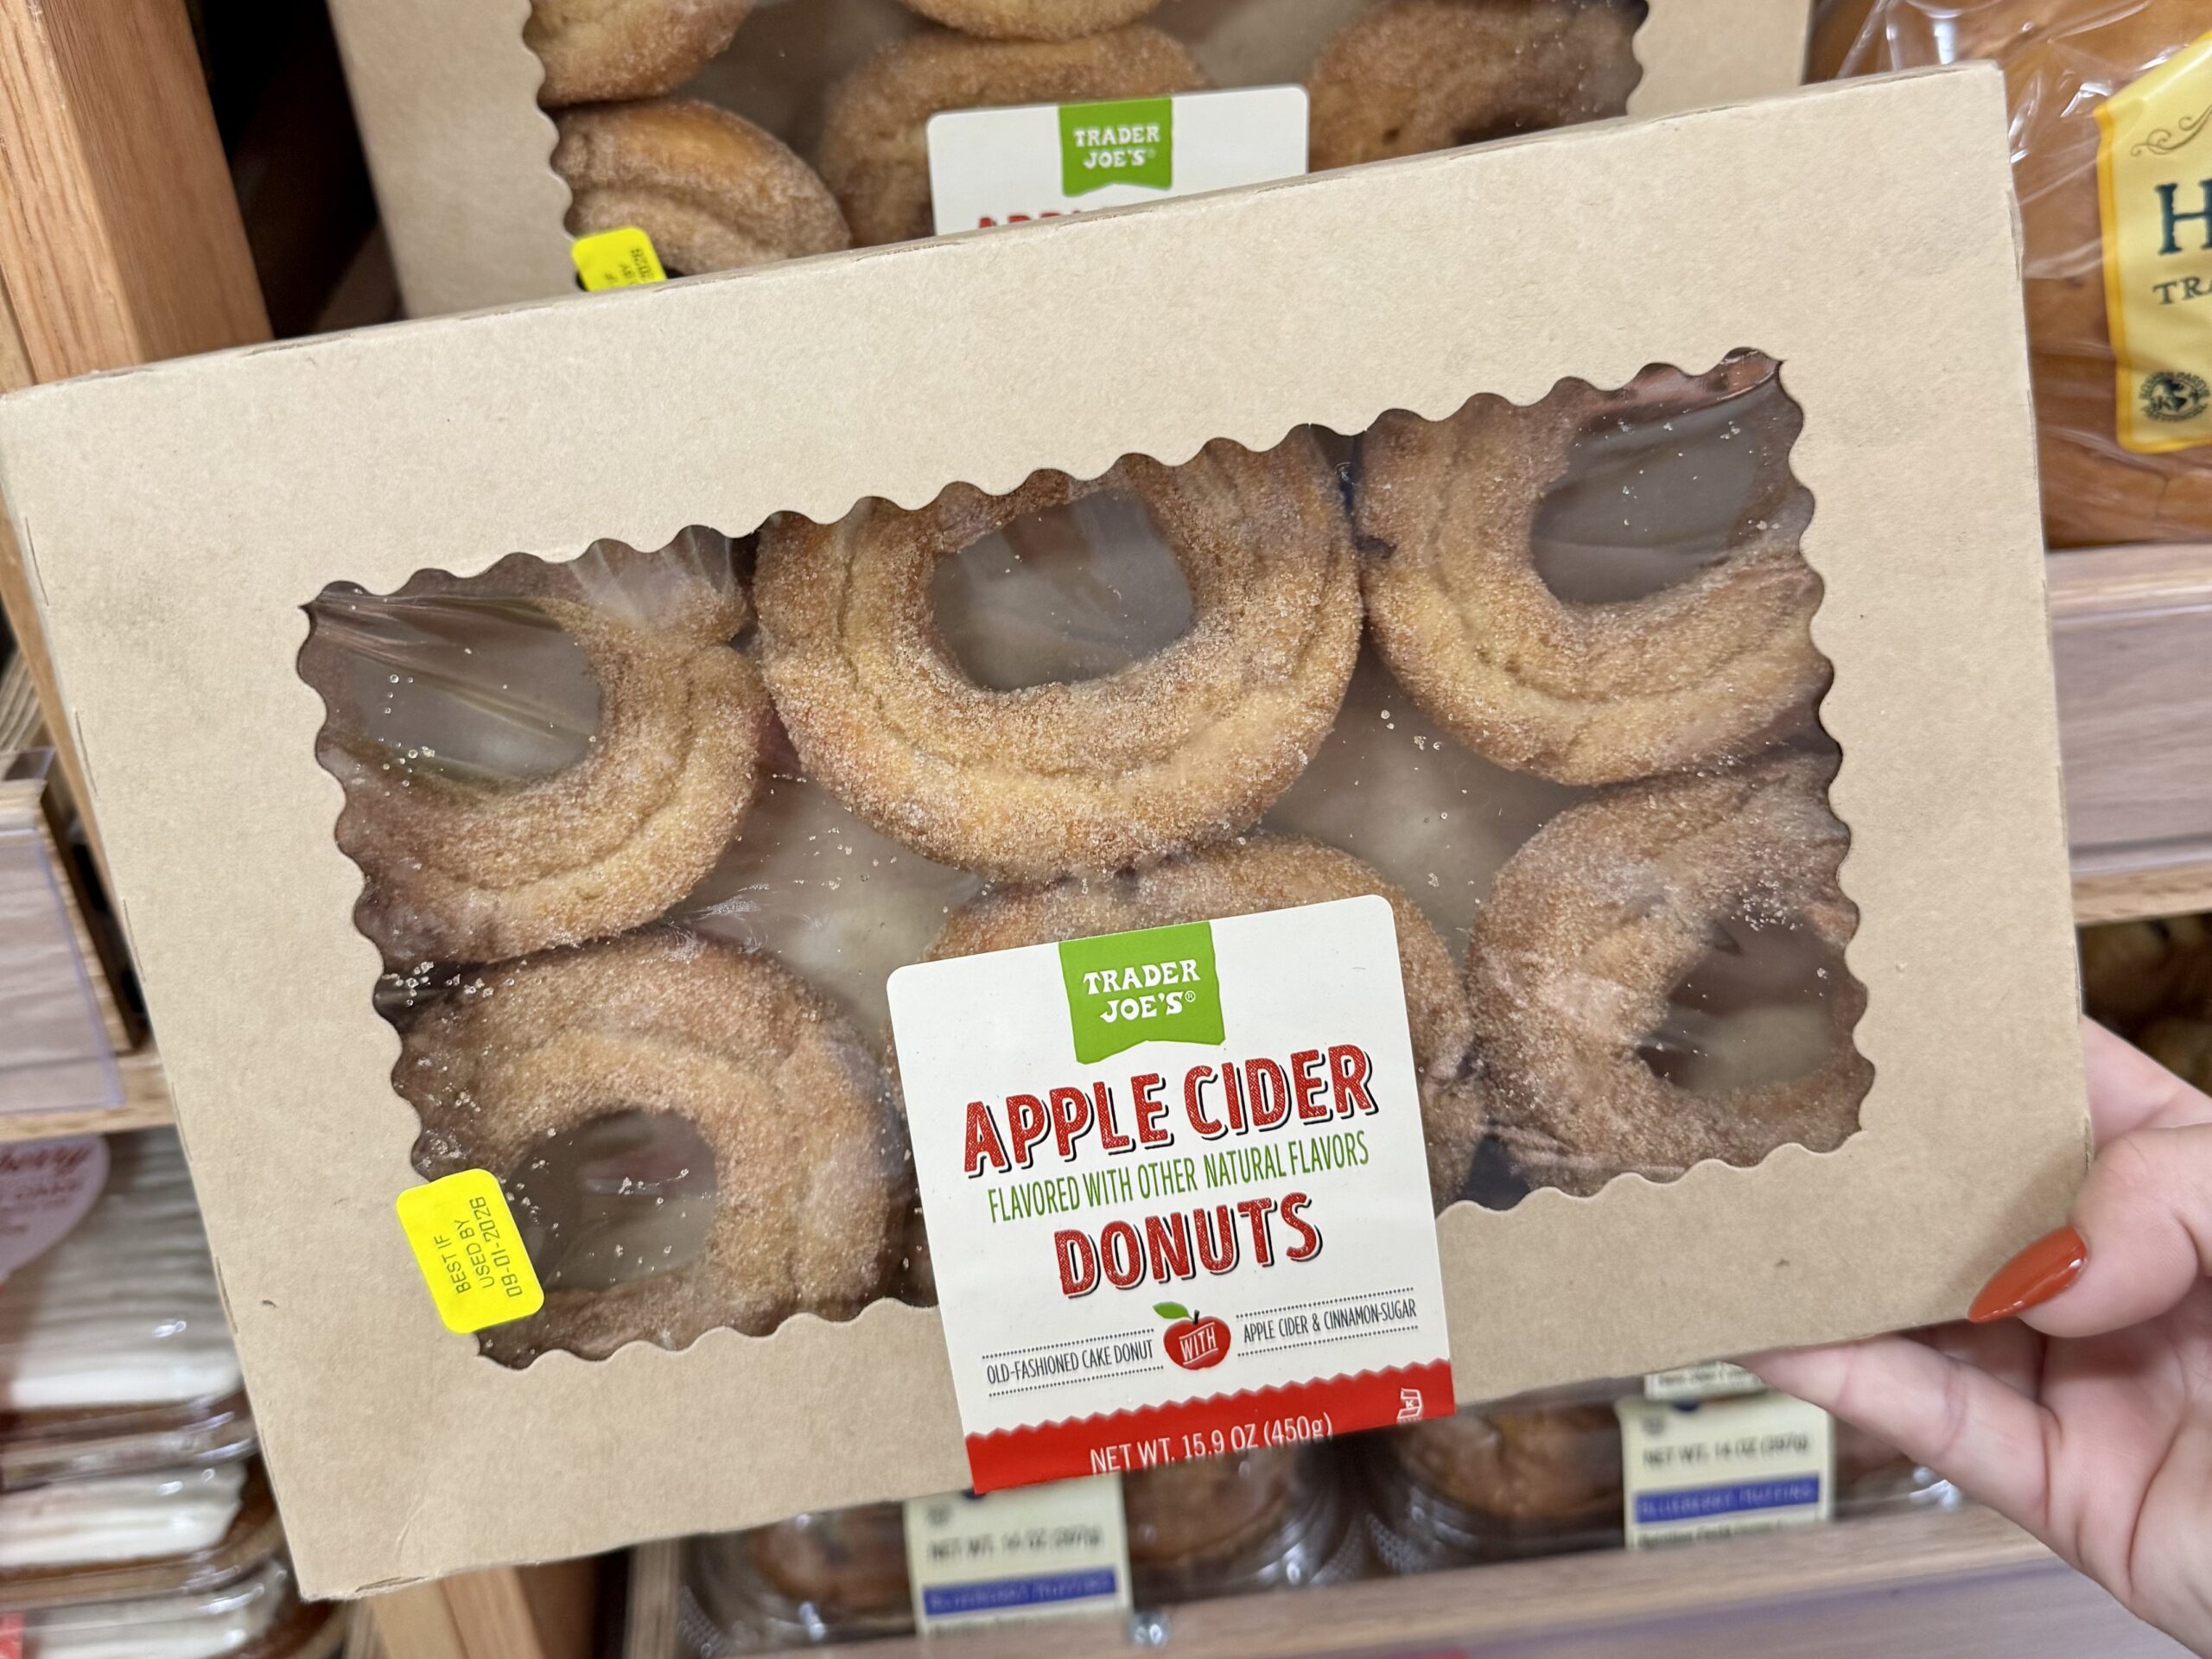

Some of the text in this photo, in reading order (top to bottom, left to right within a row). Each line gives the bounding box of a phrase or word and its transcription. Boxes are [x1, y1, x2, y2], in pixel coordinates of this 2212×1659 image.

[1073, 124, 1160, 148] TRADER
[1084, 959, 1201, 995] TRADER
[964, 1045, 1378, 1179] APPLE CIDER
[988, 1130, 1370, 1223] FLAVORED WITH OTHER NATURAL FLAVORS
[433, 1234, 472, 1294] BEST IF
[454, 1219, 495, 1288] USED BY
[469, 1196, 523, 1298] 09-01-2026
[1054, 1192, 1322, 1298] DONUTS
[1179, 1325, 1217, 1363] WITH
[1244, 1298, 1417, 1343] APPLE CIDER & CINNAMON-SUGAR
[987, 1339, 1154, 1384] OLD-FASHIONED CAKE DONUT
[1090, 1412, 1332, 1475] NET WT. 15.9 OZ (450g)
